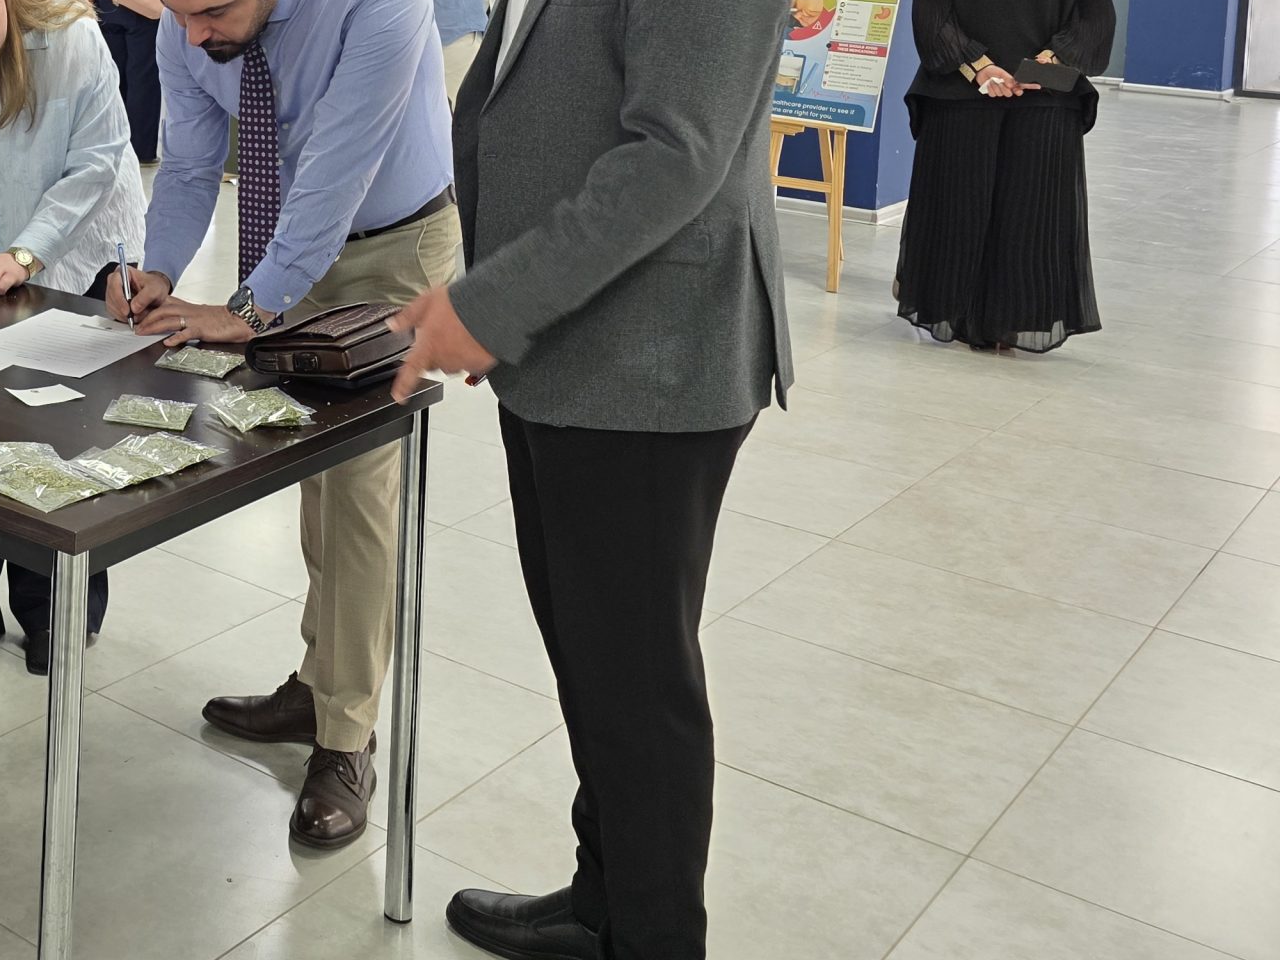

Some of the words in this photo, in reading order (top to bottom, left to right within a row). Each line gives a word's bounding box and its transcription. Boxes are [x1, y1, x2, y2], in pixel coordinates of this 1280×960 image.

[772, 100, 801, 108] ealthcare
[802, 103, 828, 112] provider
[794, 109, 809, 117] right
